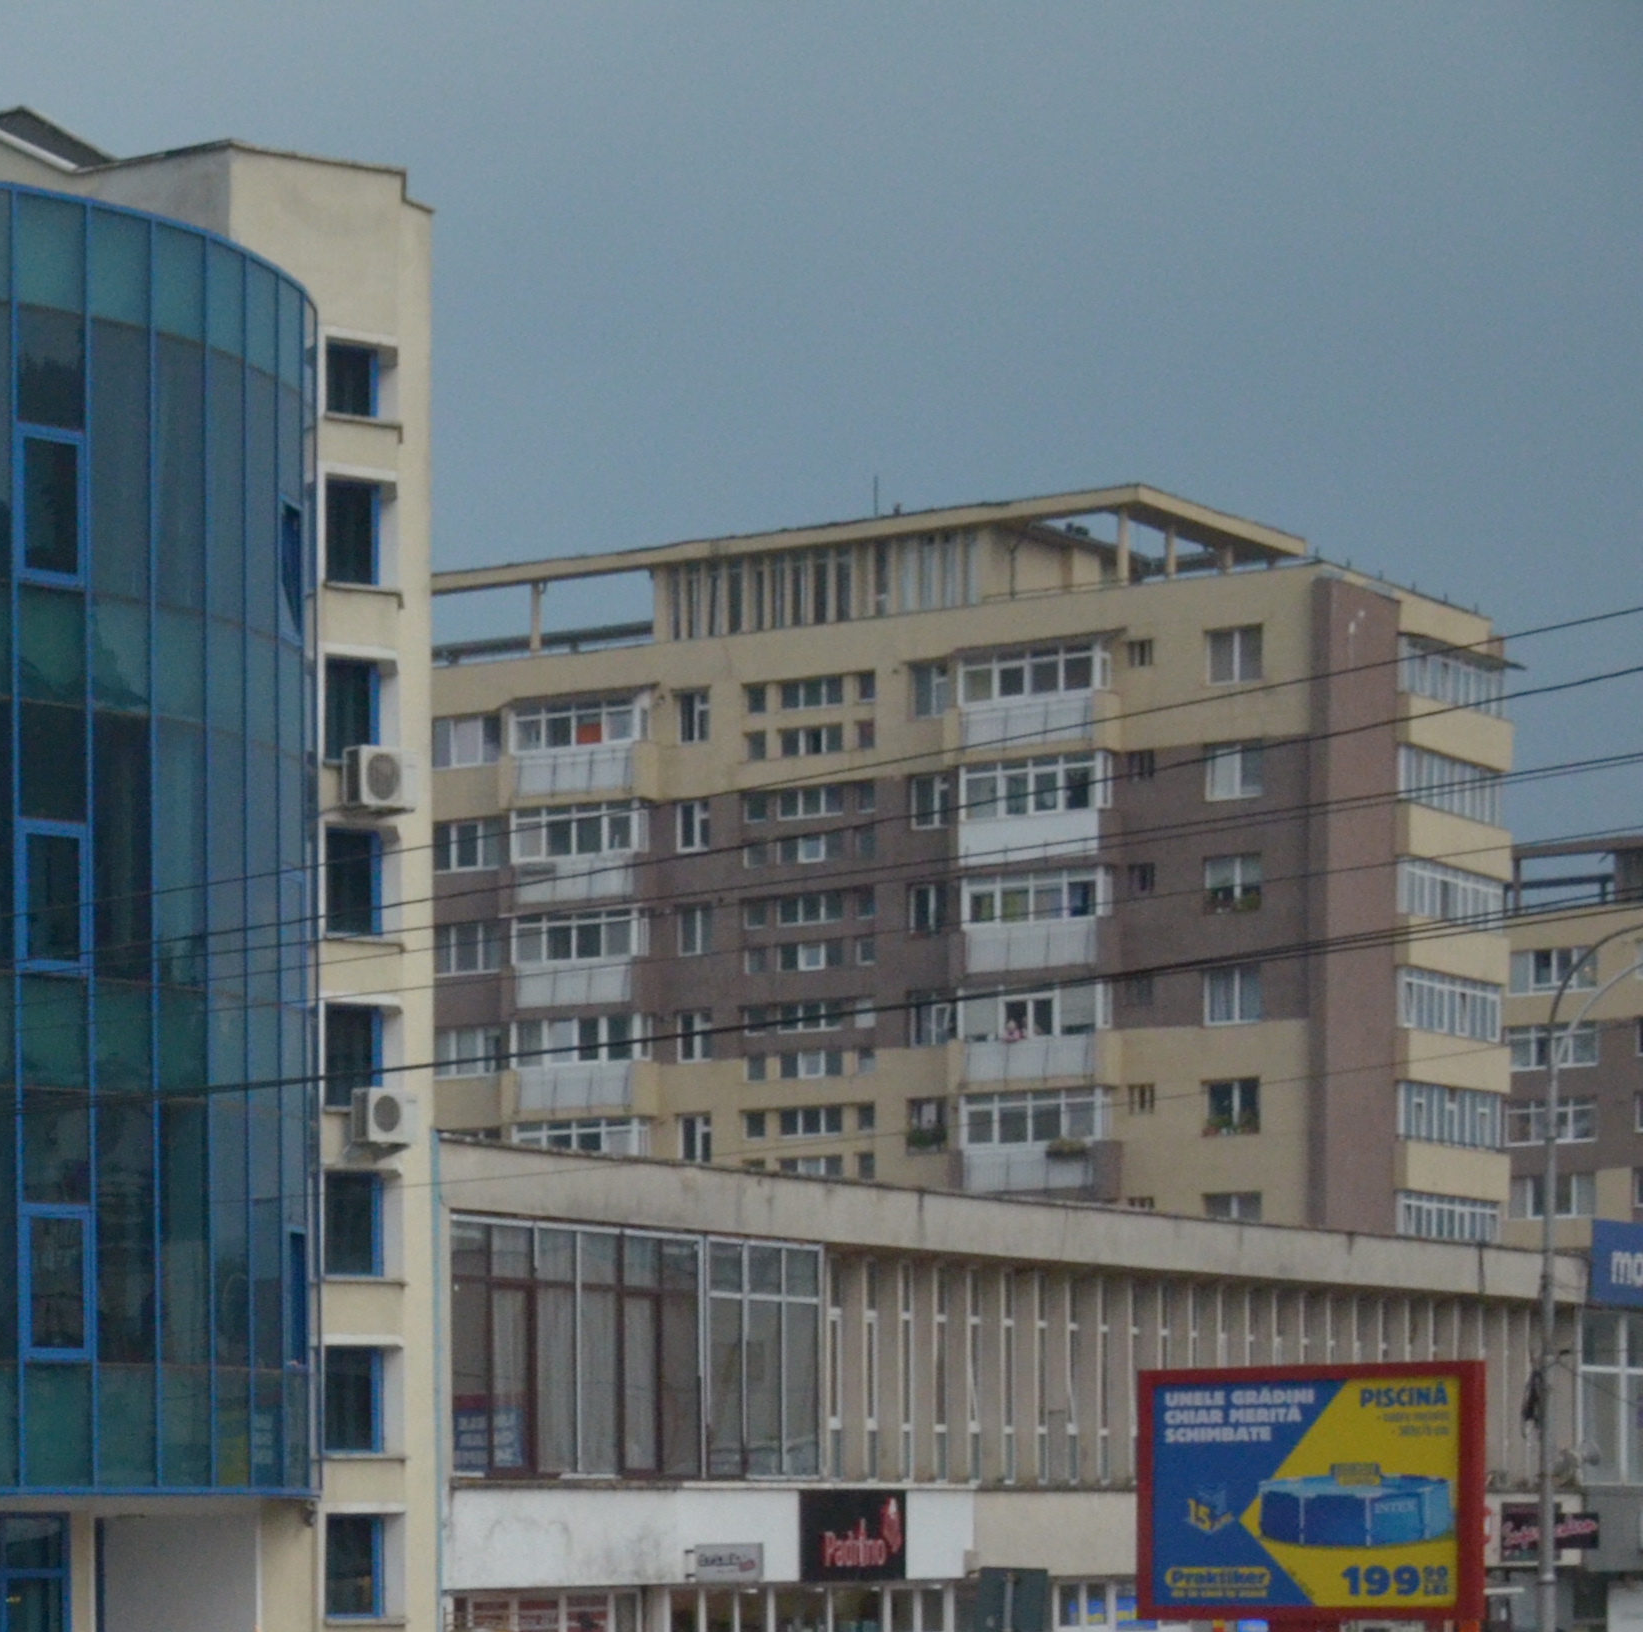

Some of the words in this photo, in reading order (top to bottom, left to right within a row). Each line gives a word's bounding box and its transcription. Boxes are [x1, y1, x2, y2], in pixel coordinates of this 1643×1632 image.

[1165, 1390, 1225, 1407] UNELE
[1164, 1409, 1223, 1425] CHIAR
[1164, 1426, 1272, 1443] SCHIMBATE
[1341, 1565, 1421, 1596] 199
